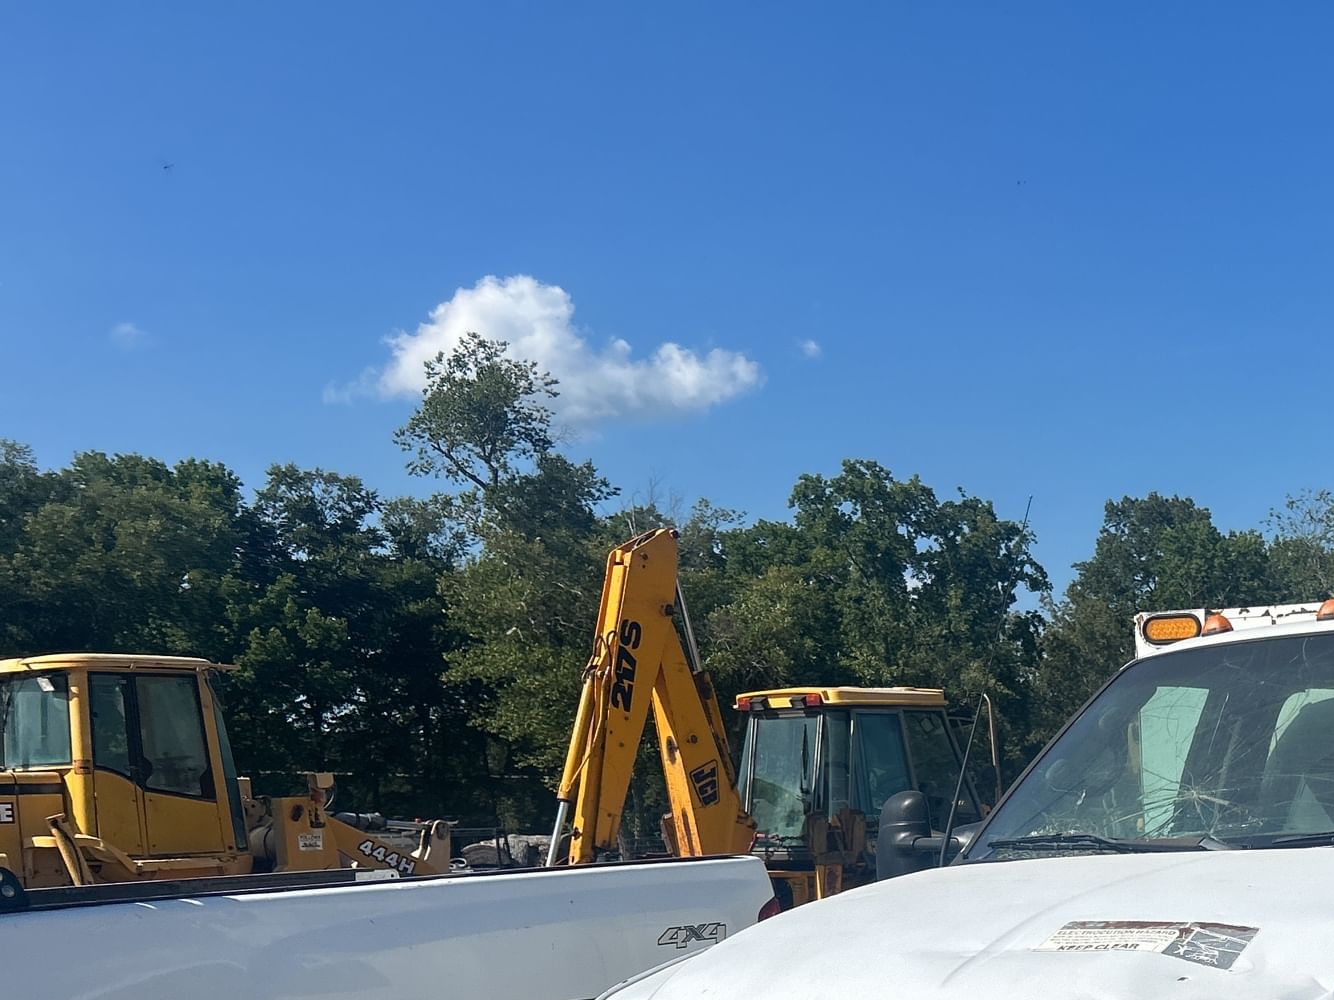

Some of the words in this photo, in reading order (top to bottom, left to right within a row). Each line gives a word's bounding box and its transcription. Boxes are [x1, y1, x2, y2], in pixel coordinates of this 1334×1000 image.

[612, 619, 642, 712] 217S
[359, 841, 416, 874] 444H
[1057, 943, 1093, 951] KEEP
